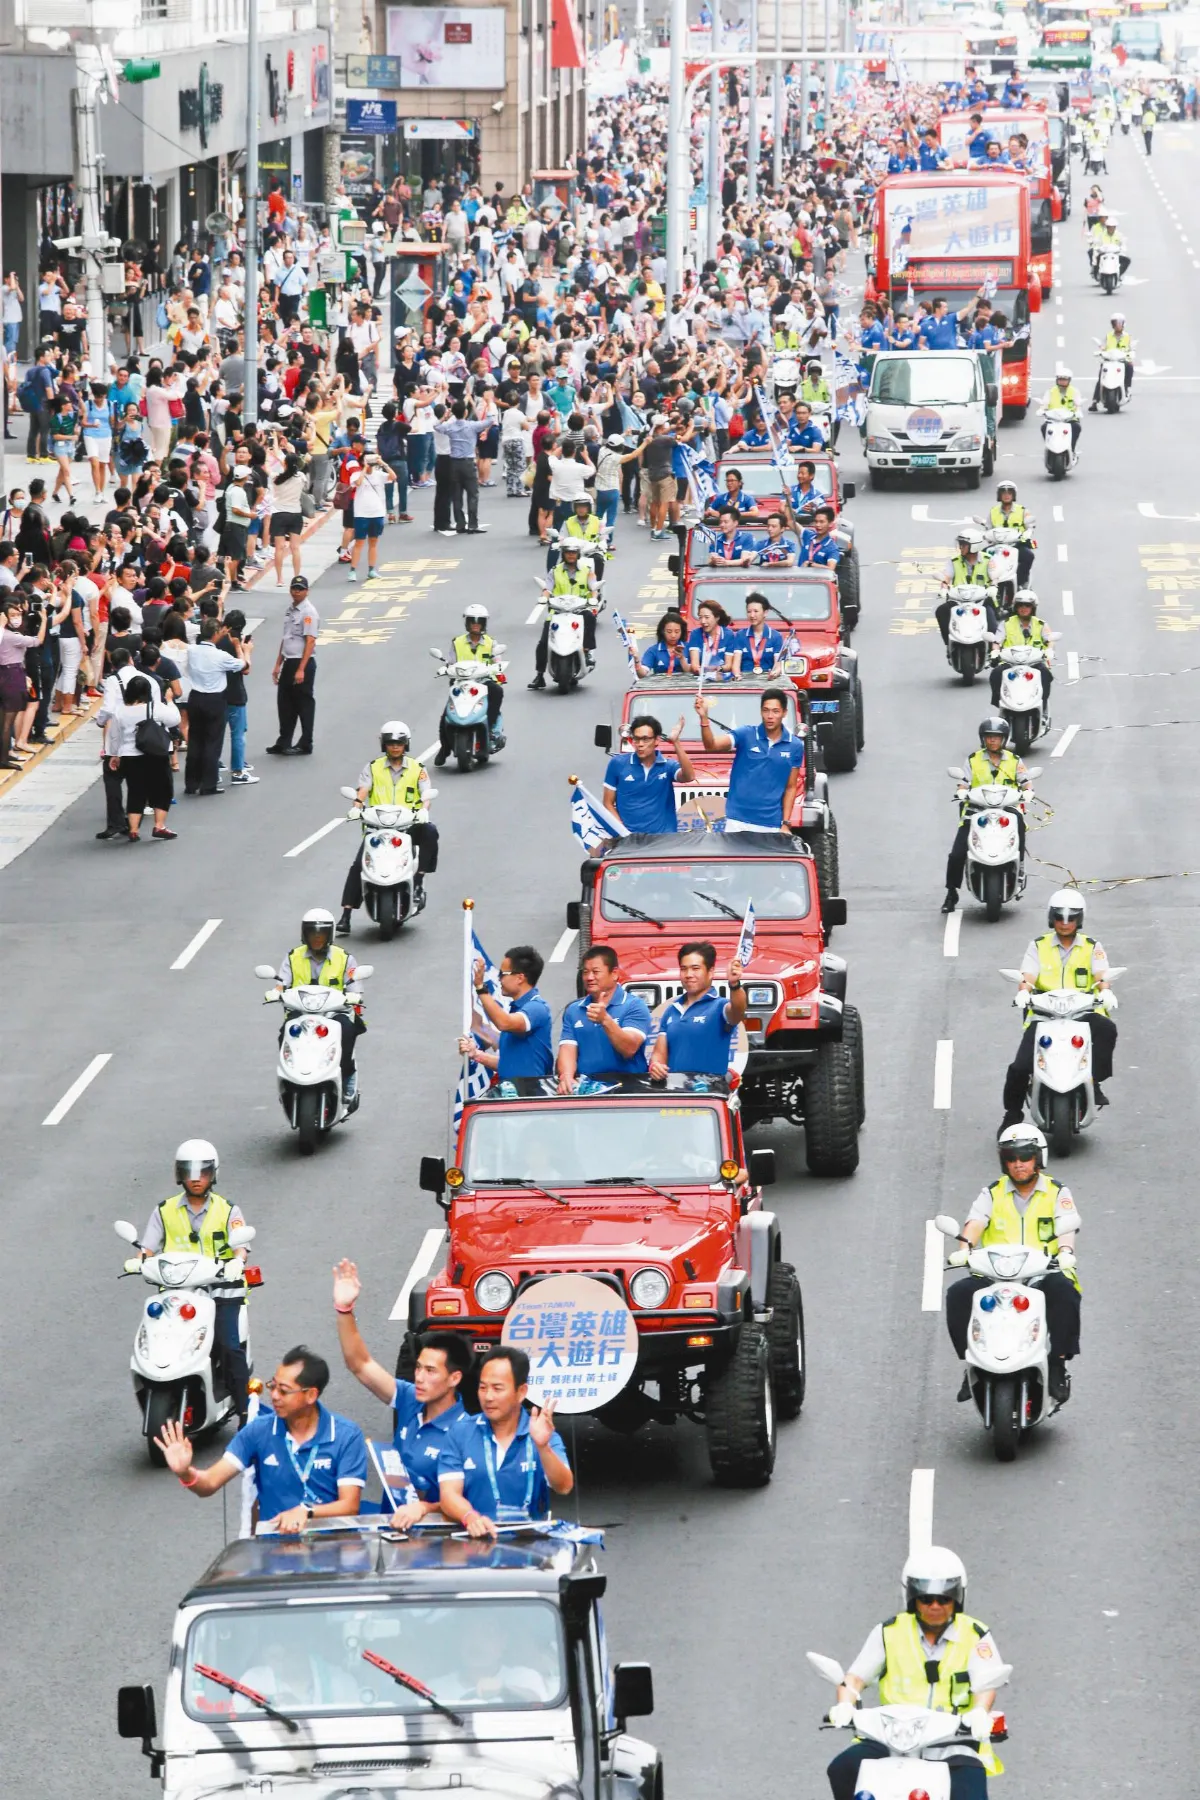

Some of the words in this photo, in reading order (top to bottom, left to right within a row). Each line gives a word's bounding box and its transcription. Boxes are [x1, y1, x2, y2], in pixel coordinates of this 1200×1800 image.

[508, 1310, 628, 1340] 台灣英雄
[537, 1339, 626, 1368] 大遊行
[424, 1446, 441, 1460] TPE
[313, 1458, 332, 1470] TPE
